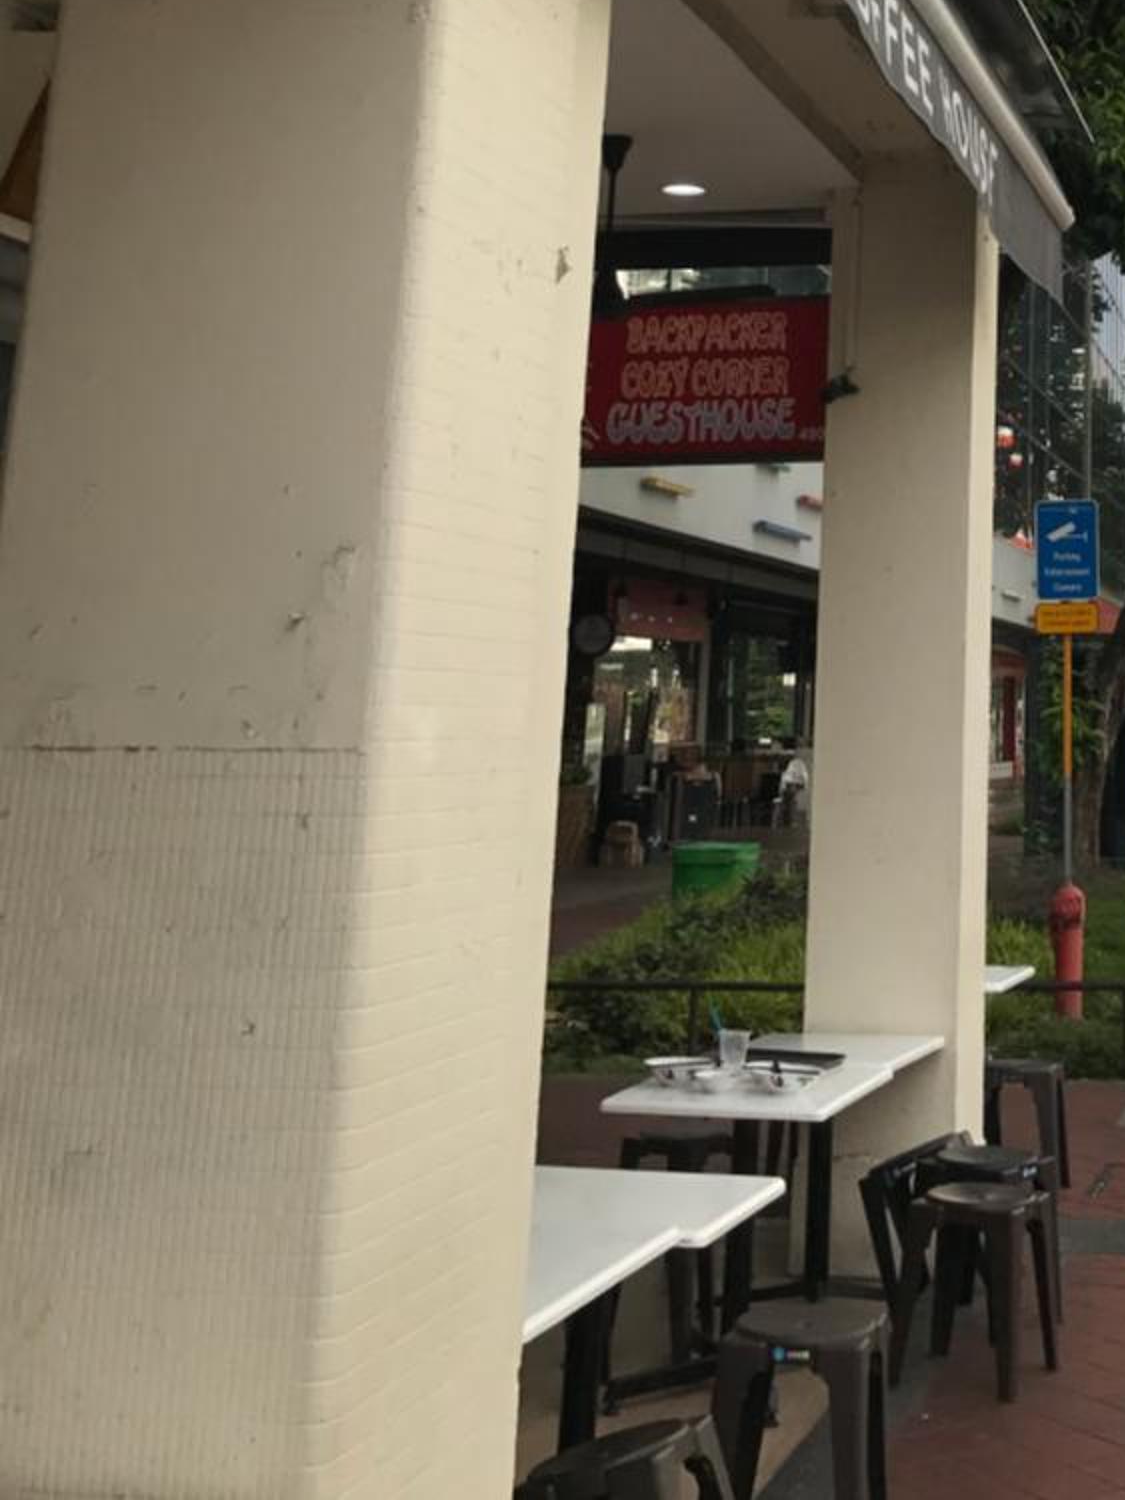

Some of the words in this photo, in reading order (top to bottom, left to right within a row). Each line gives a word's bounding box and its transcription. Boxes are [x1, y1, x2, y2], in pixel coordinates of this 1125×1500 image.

[938, 62, 998, 207] HOUSE
[625, 310, 788, 354] BACKPACKER
[621, 356, 690, 400] COZY
[692, 355, 790, 399] CORNER
[606, 397, 797, 445] GUESTHOUSE
